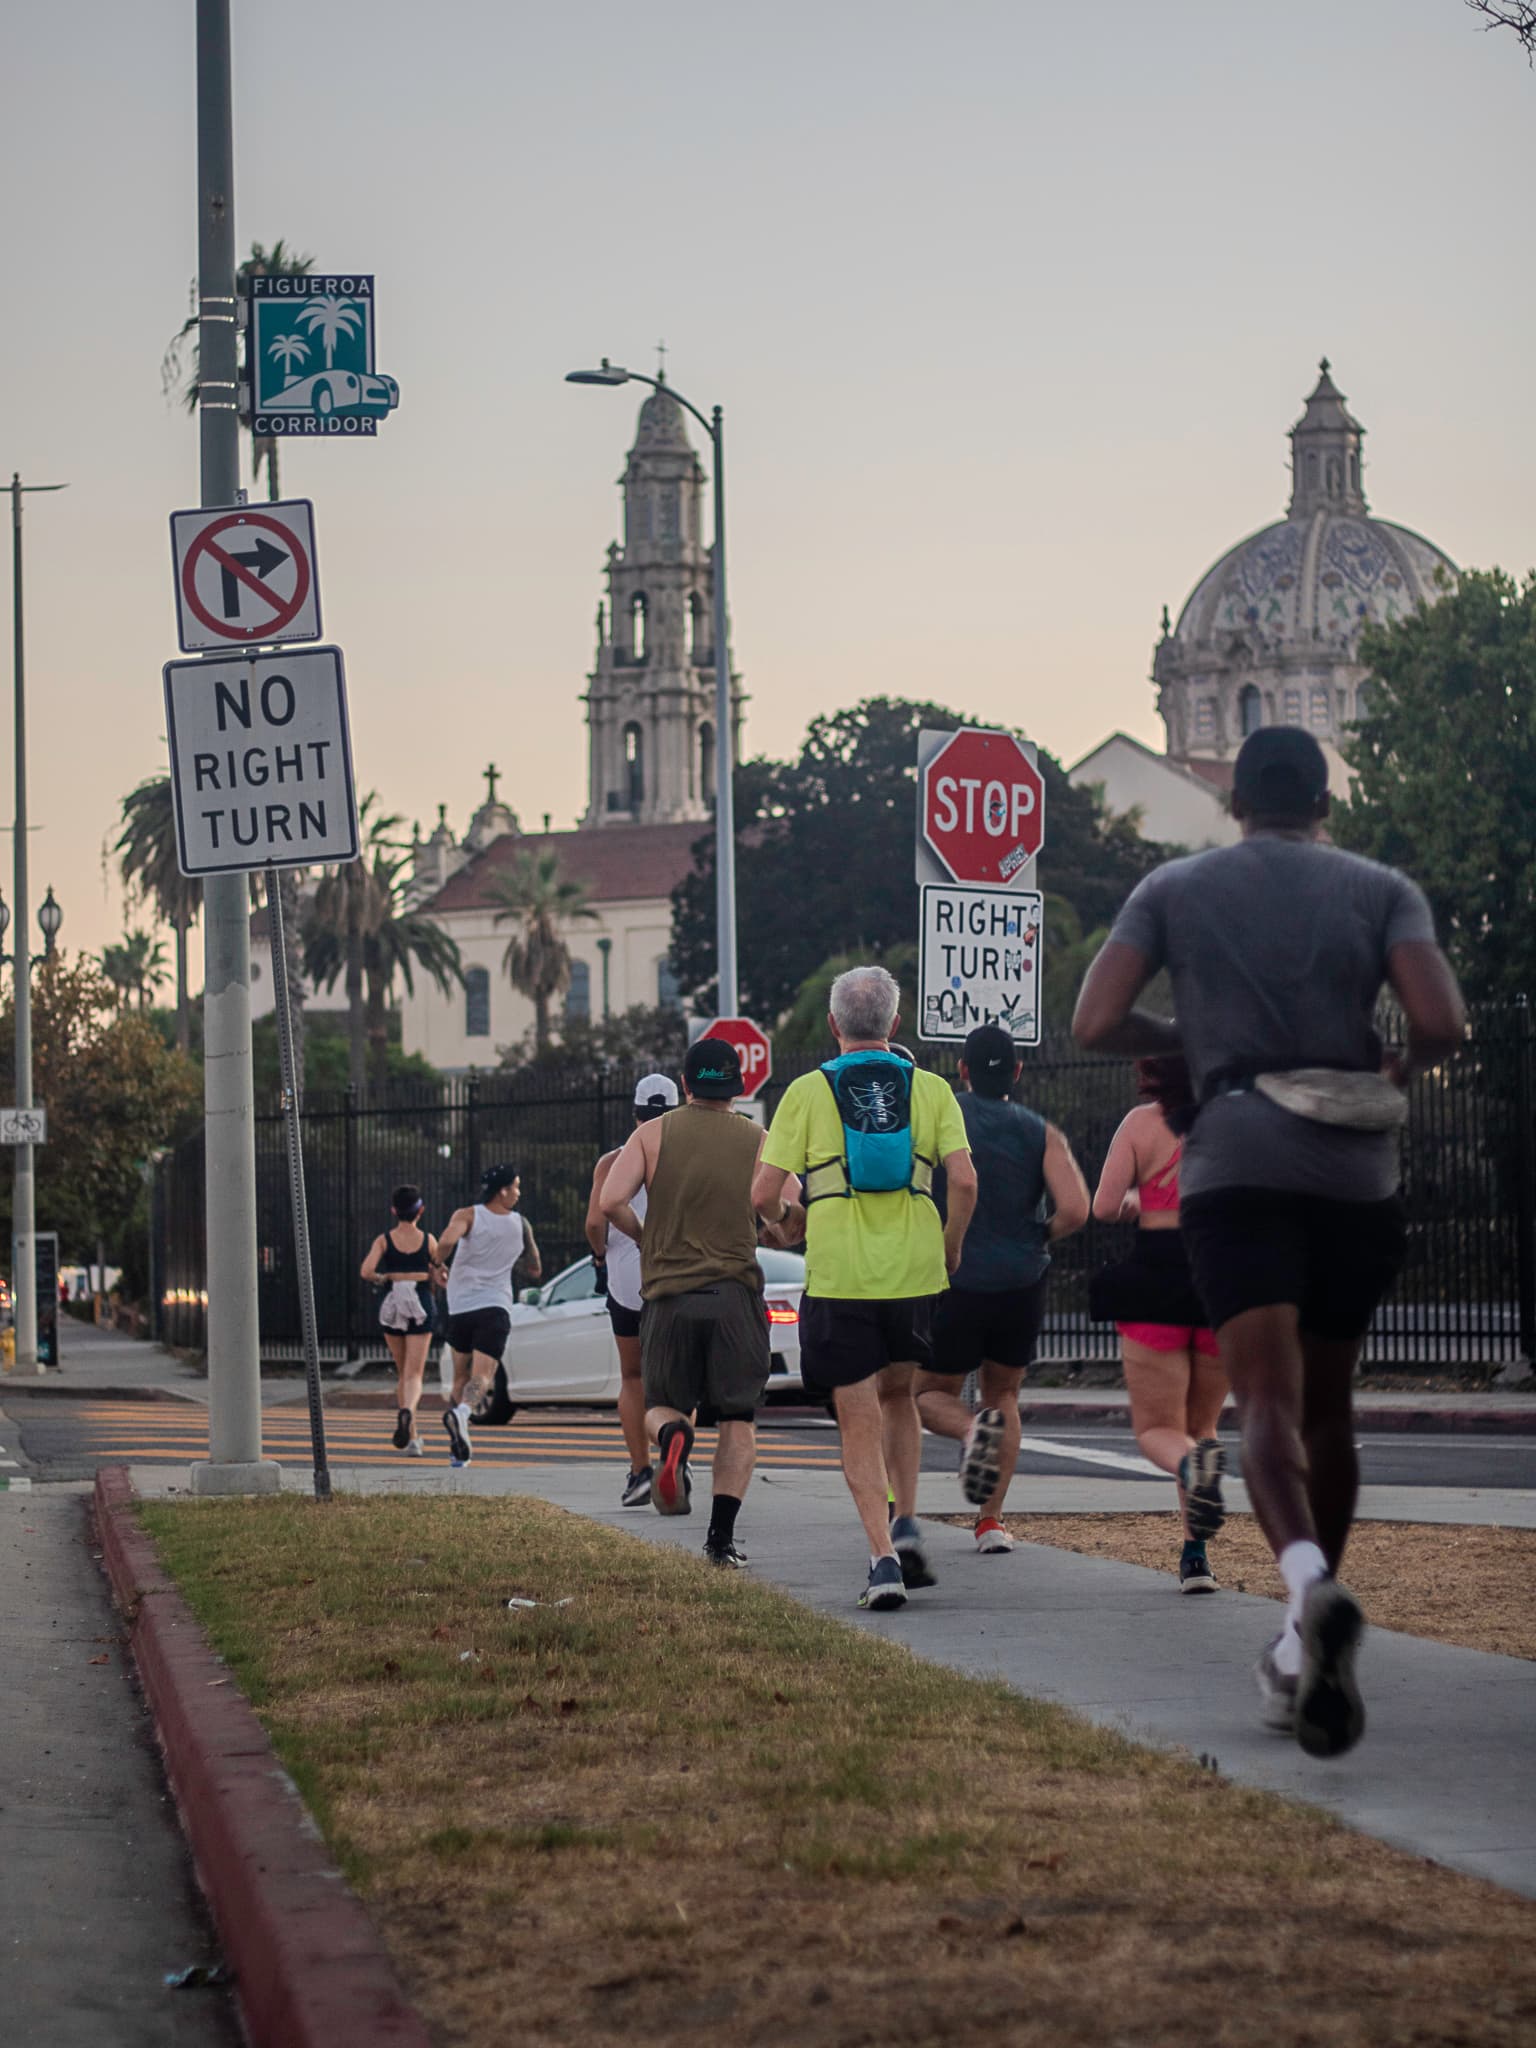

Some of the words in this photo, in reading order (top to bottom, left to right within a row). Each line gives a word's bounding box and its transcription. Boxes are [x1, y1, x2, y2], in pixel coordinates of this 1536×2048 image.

[253, 278, 371, 294] FIGUEROA
[254, 417, 374, 433] CORRIDOR
[214, 675, 296, 732] NO
[193, 741, 331, 791] RIGHT
[201, 800, 328, 849] TURN
[934, 776, 1035, 838] STOP
[936, 900, 1027, 938] RIGHT
[941, 944, 1022, 981] TURN
[734, 1042, 766, 1073] OP
